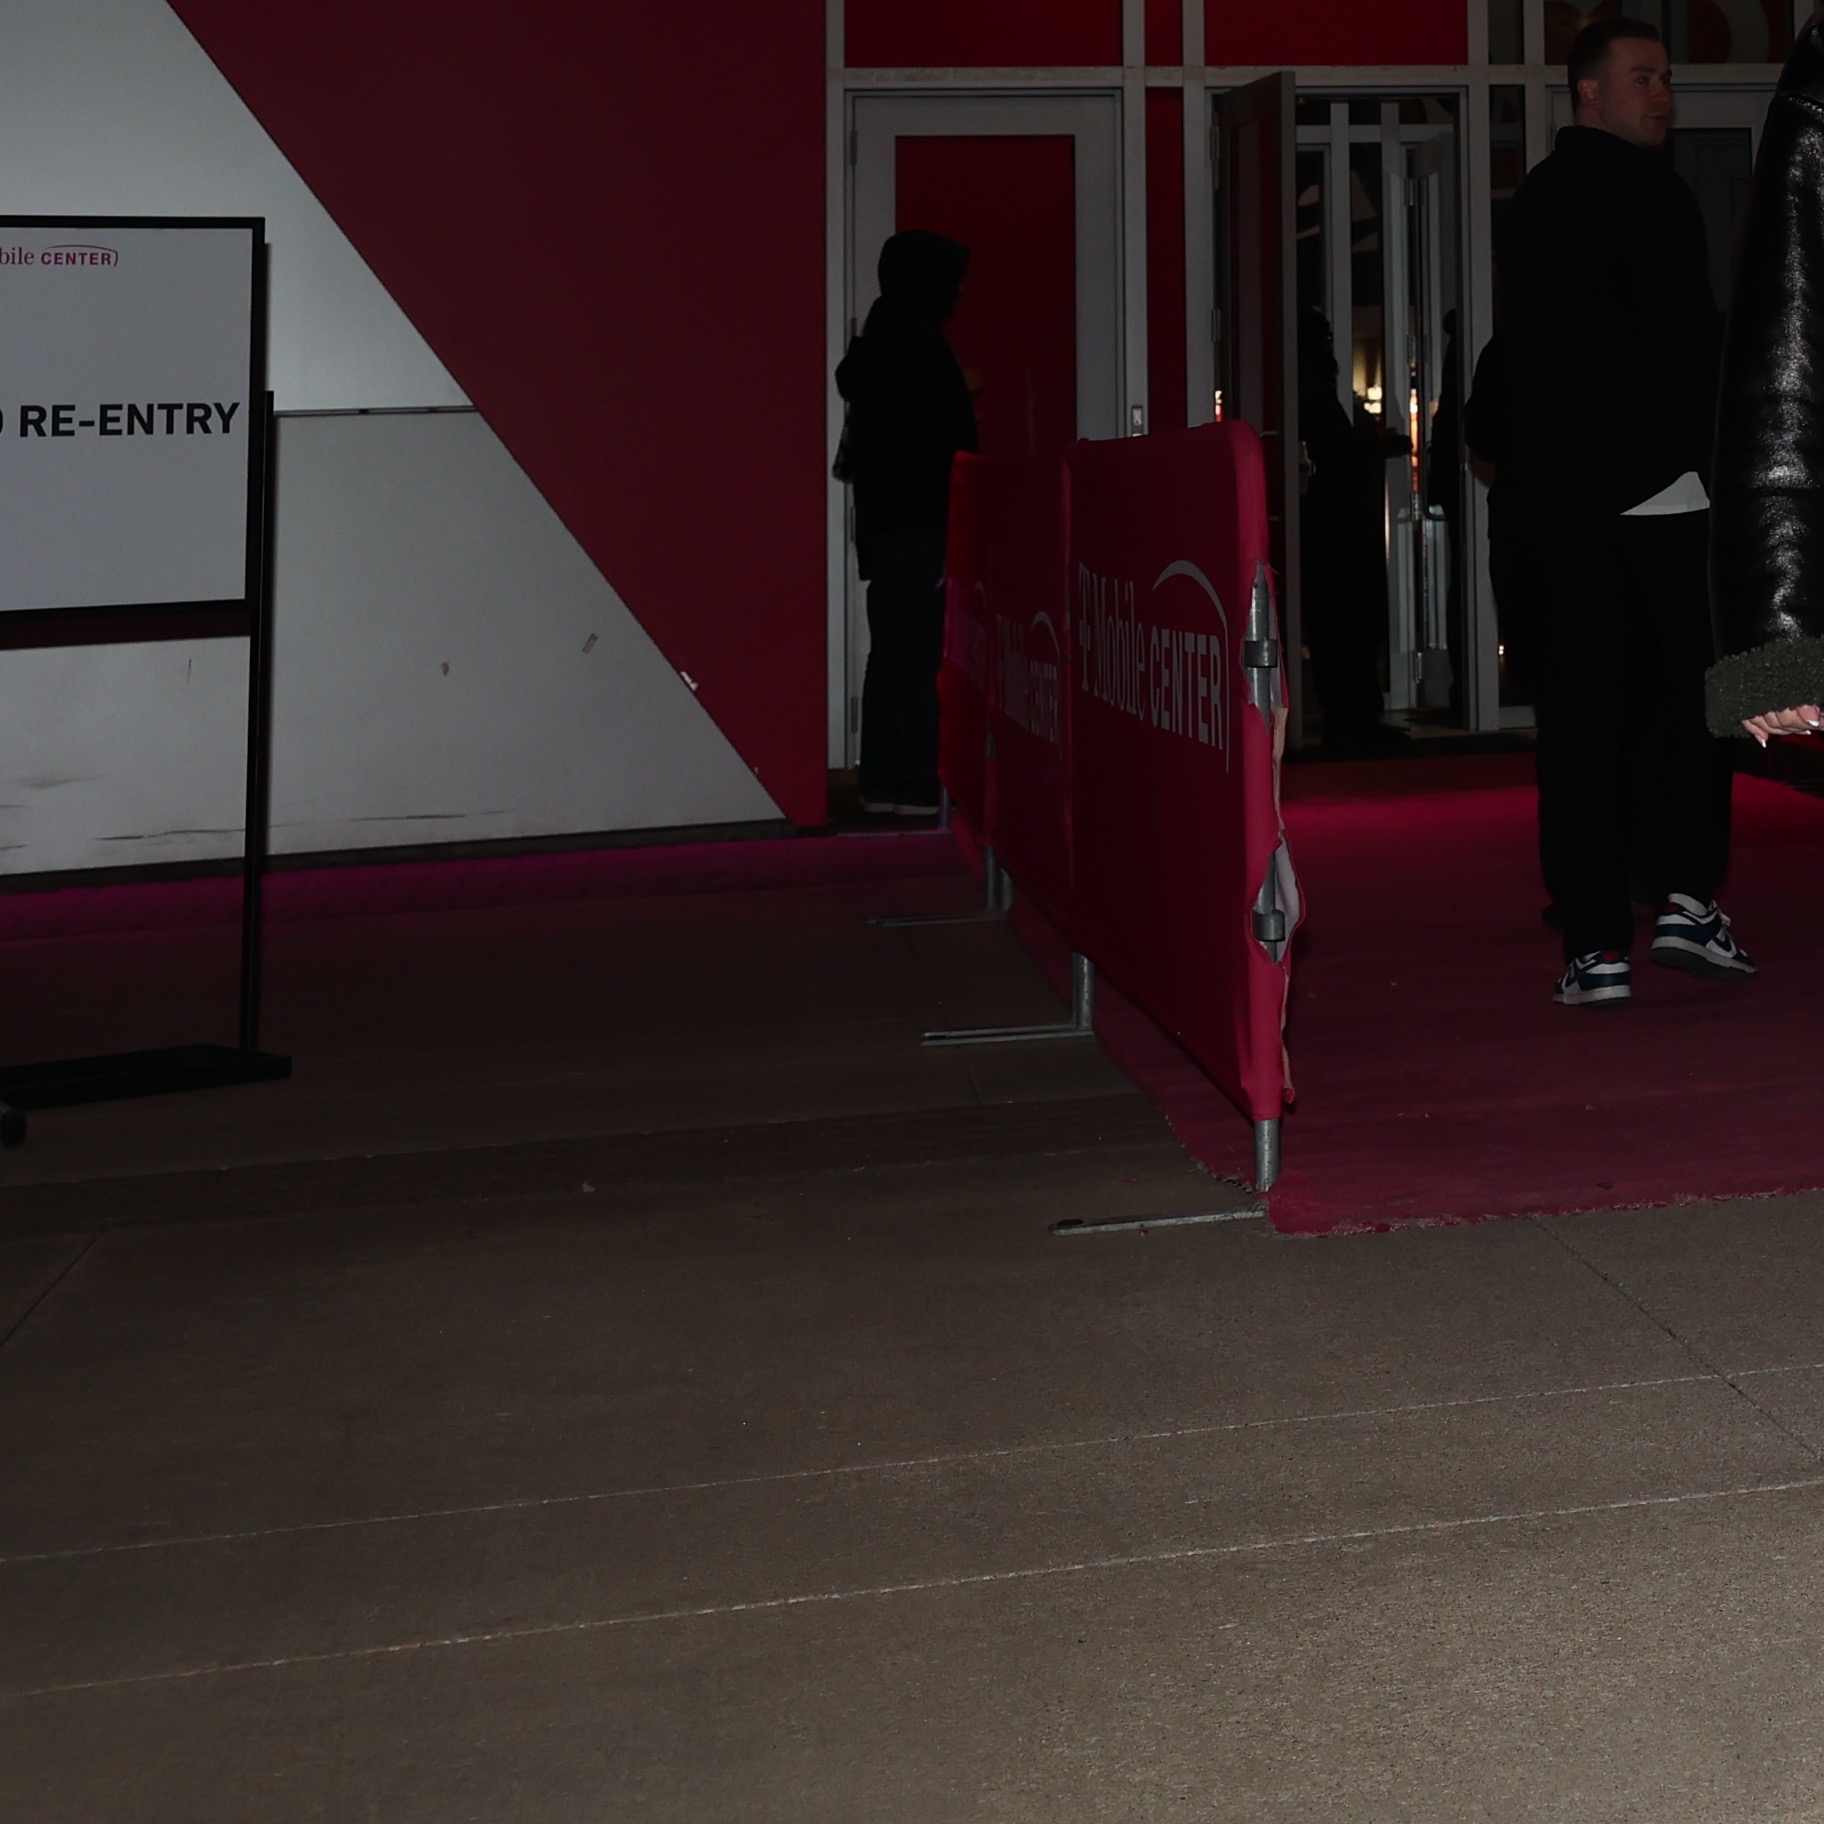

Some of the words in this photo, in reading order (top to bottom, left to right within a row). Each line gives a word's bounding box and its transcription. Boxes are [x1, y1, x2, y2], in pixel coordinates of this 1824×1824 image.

[41, 252, 112, 266] CENTER
[19, 402, 241, 438] RE-ENTRY
[1092, 571, 1147, 721] Mobile
[1149, 624, 1224, 751] CENTER
